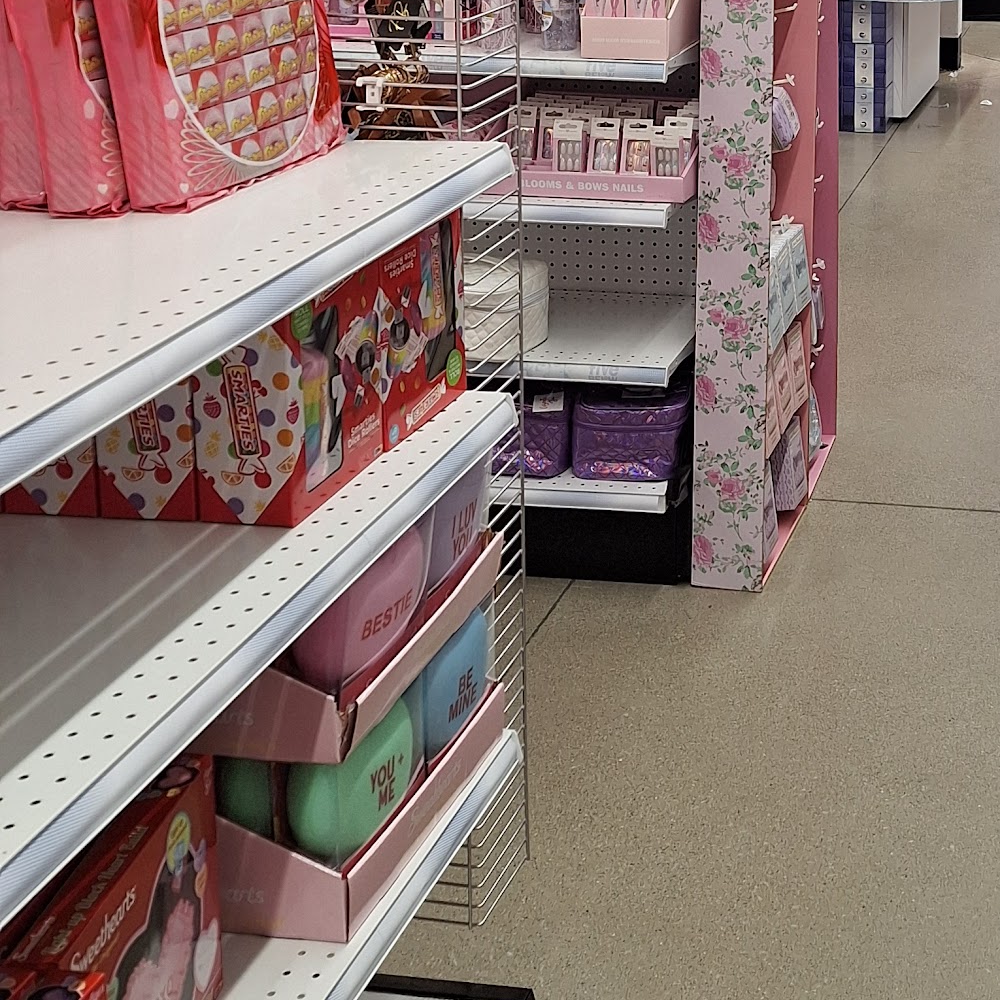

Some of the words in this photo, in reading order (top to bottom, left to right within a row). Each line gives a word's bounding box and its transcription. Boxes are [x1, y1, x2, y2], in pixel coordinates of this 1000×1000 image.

[566, 181, 574, 190] &
[578, 181, 609, 191] BOWS
[612, 183, 644, 193] NAILS
[136, 403, 155, 447] RTIES
[231, 369, 255, 452] SMARTIES
[350, 413, 376, 436] Smarties
[459, 498, 478, 533] LUV
[453, 525, 473, 561] YOU
[361, 588, 413, 641] BESTIE
[458, 666, 474, 696] BE
[448, 682, 478, 723] MINE
[370, 755, 395, 794] YOU
[378, 777, 396, 811] ME
[70, 885, 137, 972] Sweethearts
